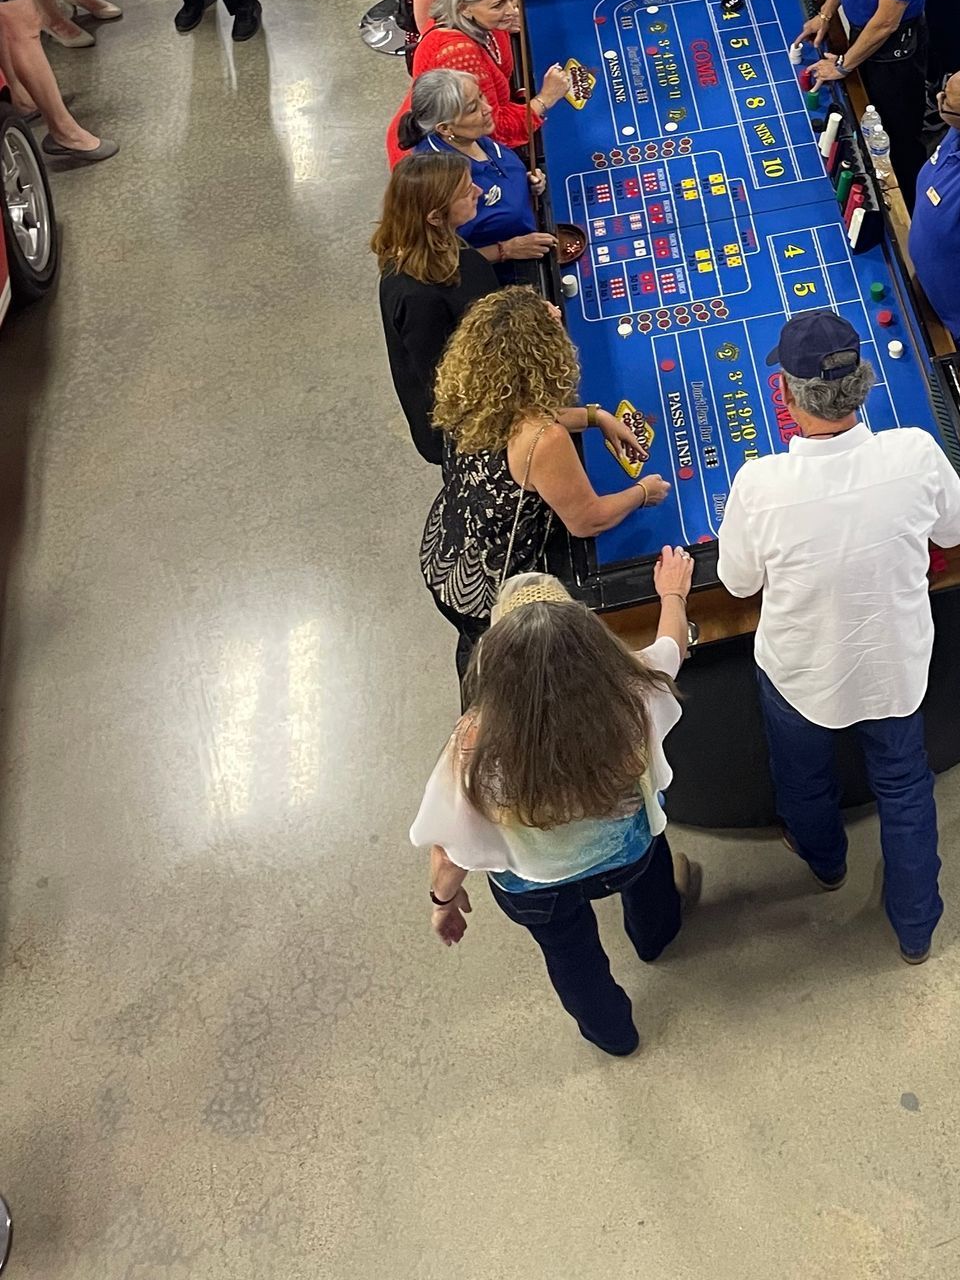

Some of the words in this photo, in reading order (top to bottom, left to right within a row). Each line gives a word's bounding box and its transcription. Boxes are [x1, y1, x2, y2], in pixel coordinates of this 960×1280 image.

[730, 38, 749, 48] 5
[691, 39, 720, 88] COME
[737, 62, 757, 81] SIX
[612, 78, 627, 104] LINE
[746, 97, 766, 109] 8
[753, 123, 776, 146] NINE
[762, 157, 785, 178] 10
[784, 244, 806, 258] 4
[793, 282, 817, 297] 5
[728, 371, 743, 382] 3
[734, 389, 749, 399] 4
[667, 392, 686, 428] PASS
[723, 392, 742, 443] FIELD
[738, 407, 753, 418] 9
[741, 422, 758, 441] 10
[673, 430, 693, 468] LINE
